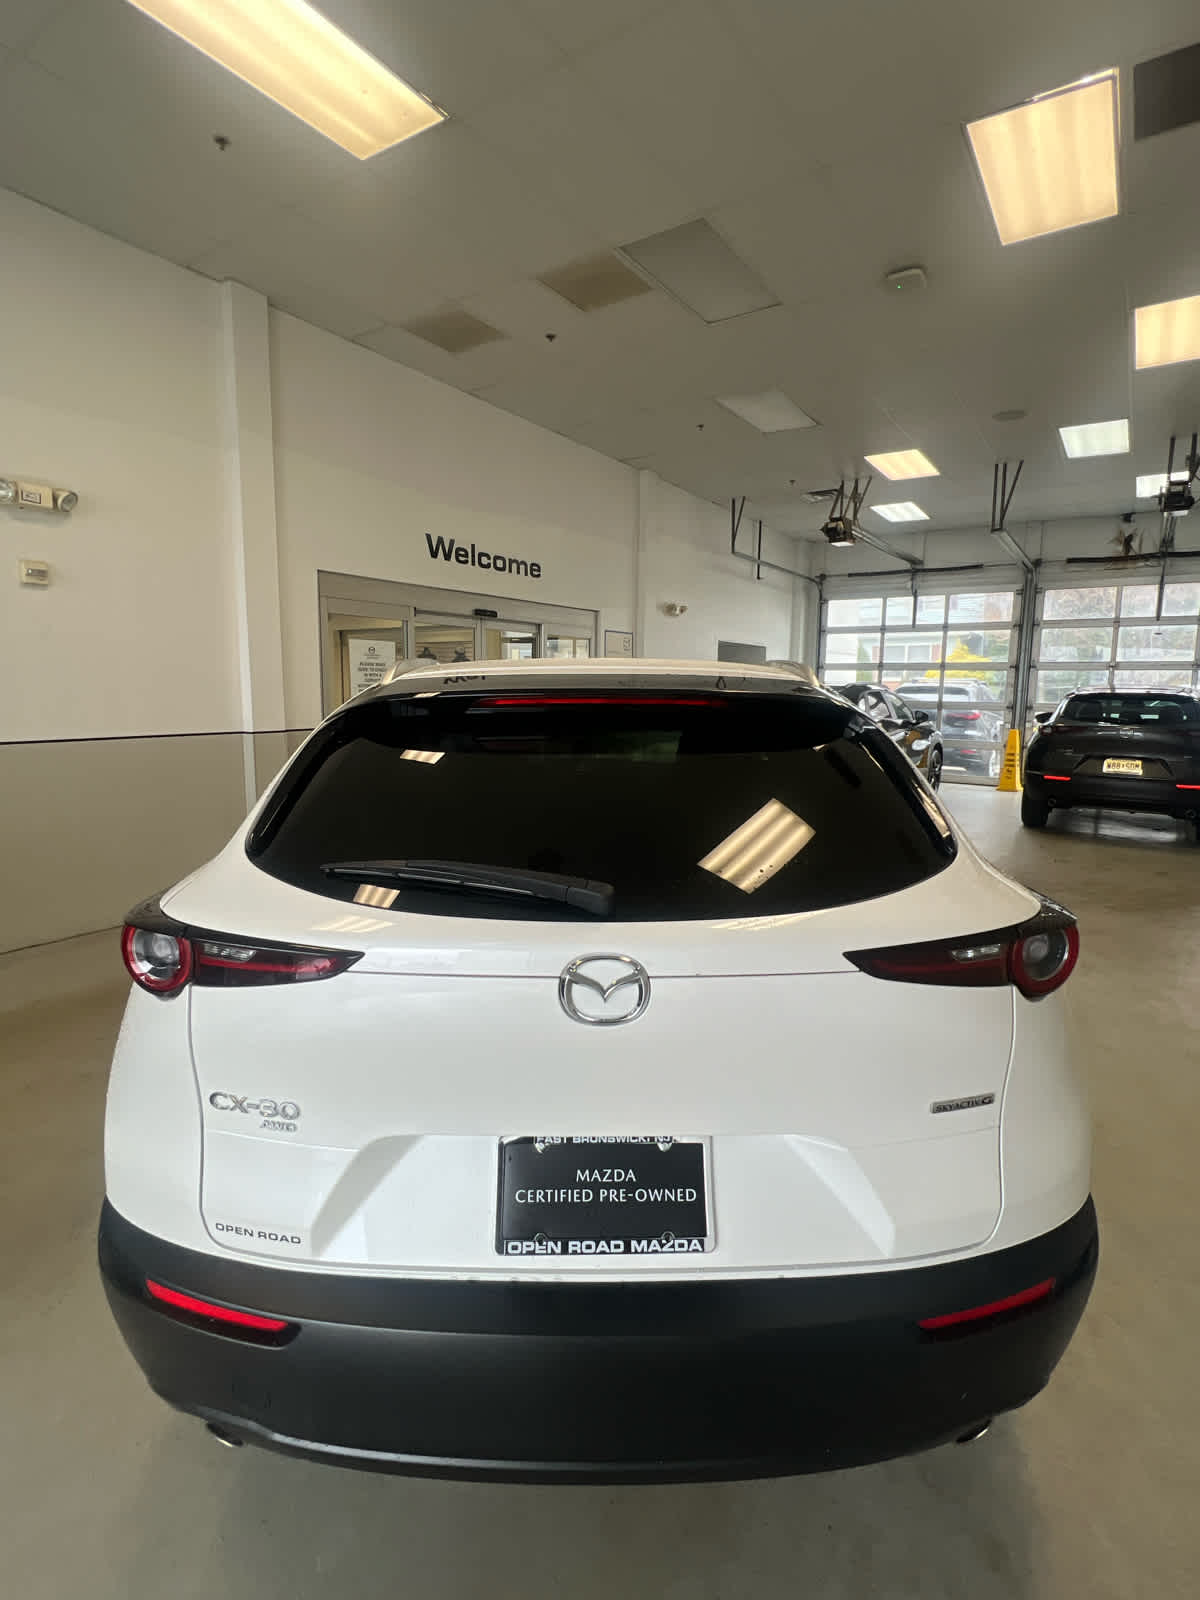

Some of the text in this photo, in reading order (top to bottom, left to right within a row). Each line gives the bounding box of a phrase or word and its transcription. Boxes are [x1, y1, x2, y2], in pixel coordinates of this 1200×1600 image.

[425, 533, 541, 578] Welcome
[209, 1091, 301, 1120] CX-30
[260, 1119, 298, 1133] AWD
[576, 1169, 637, 1182] MAZDA
[515, 1188, 697, 1203] CERTIFIED PRE-OWNED
[215, 1222, 302, 1245] OPEN ROAD
[507, 1239, 704, 1254] OPEN ROAD MAZDA
